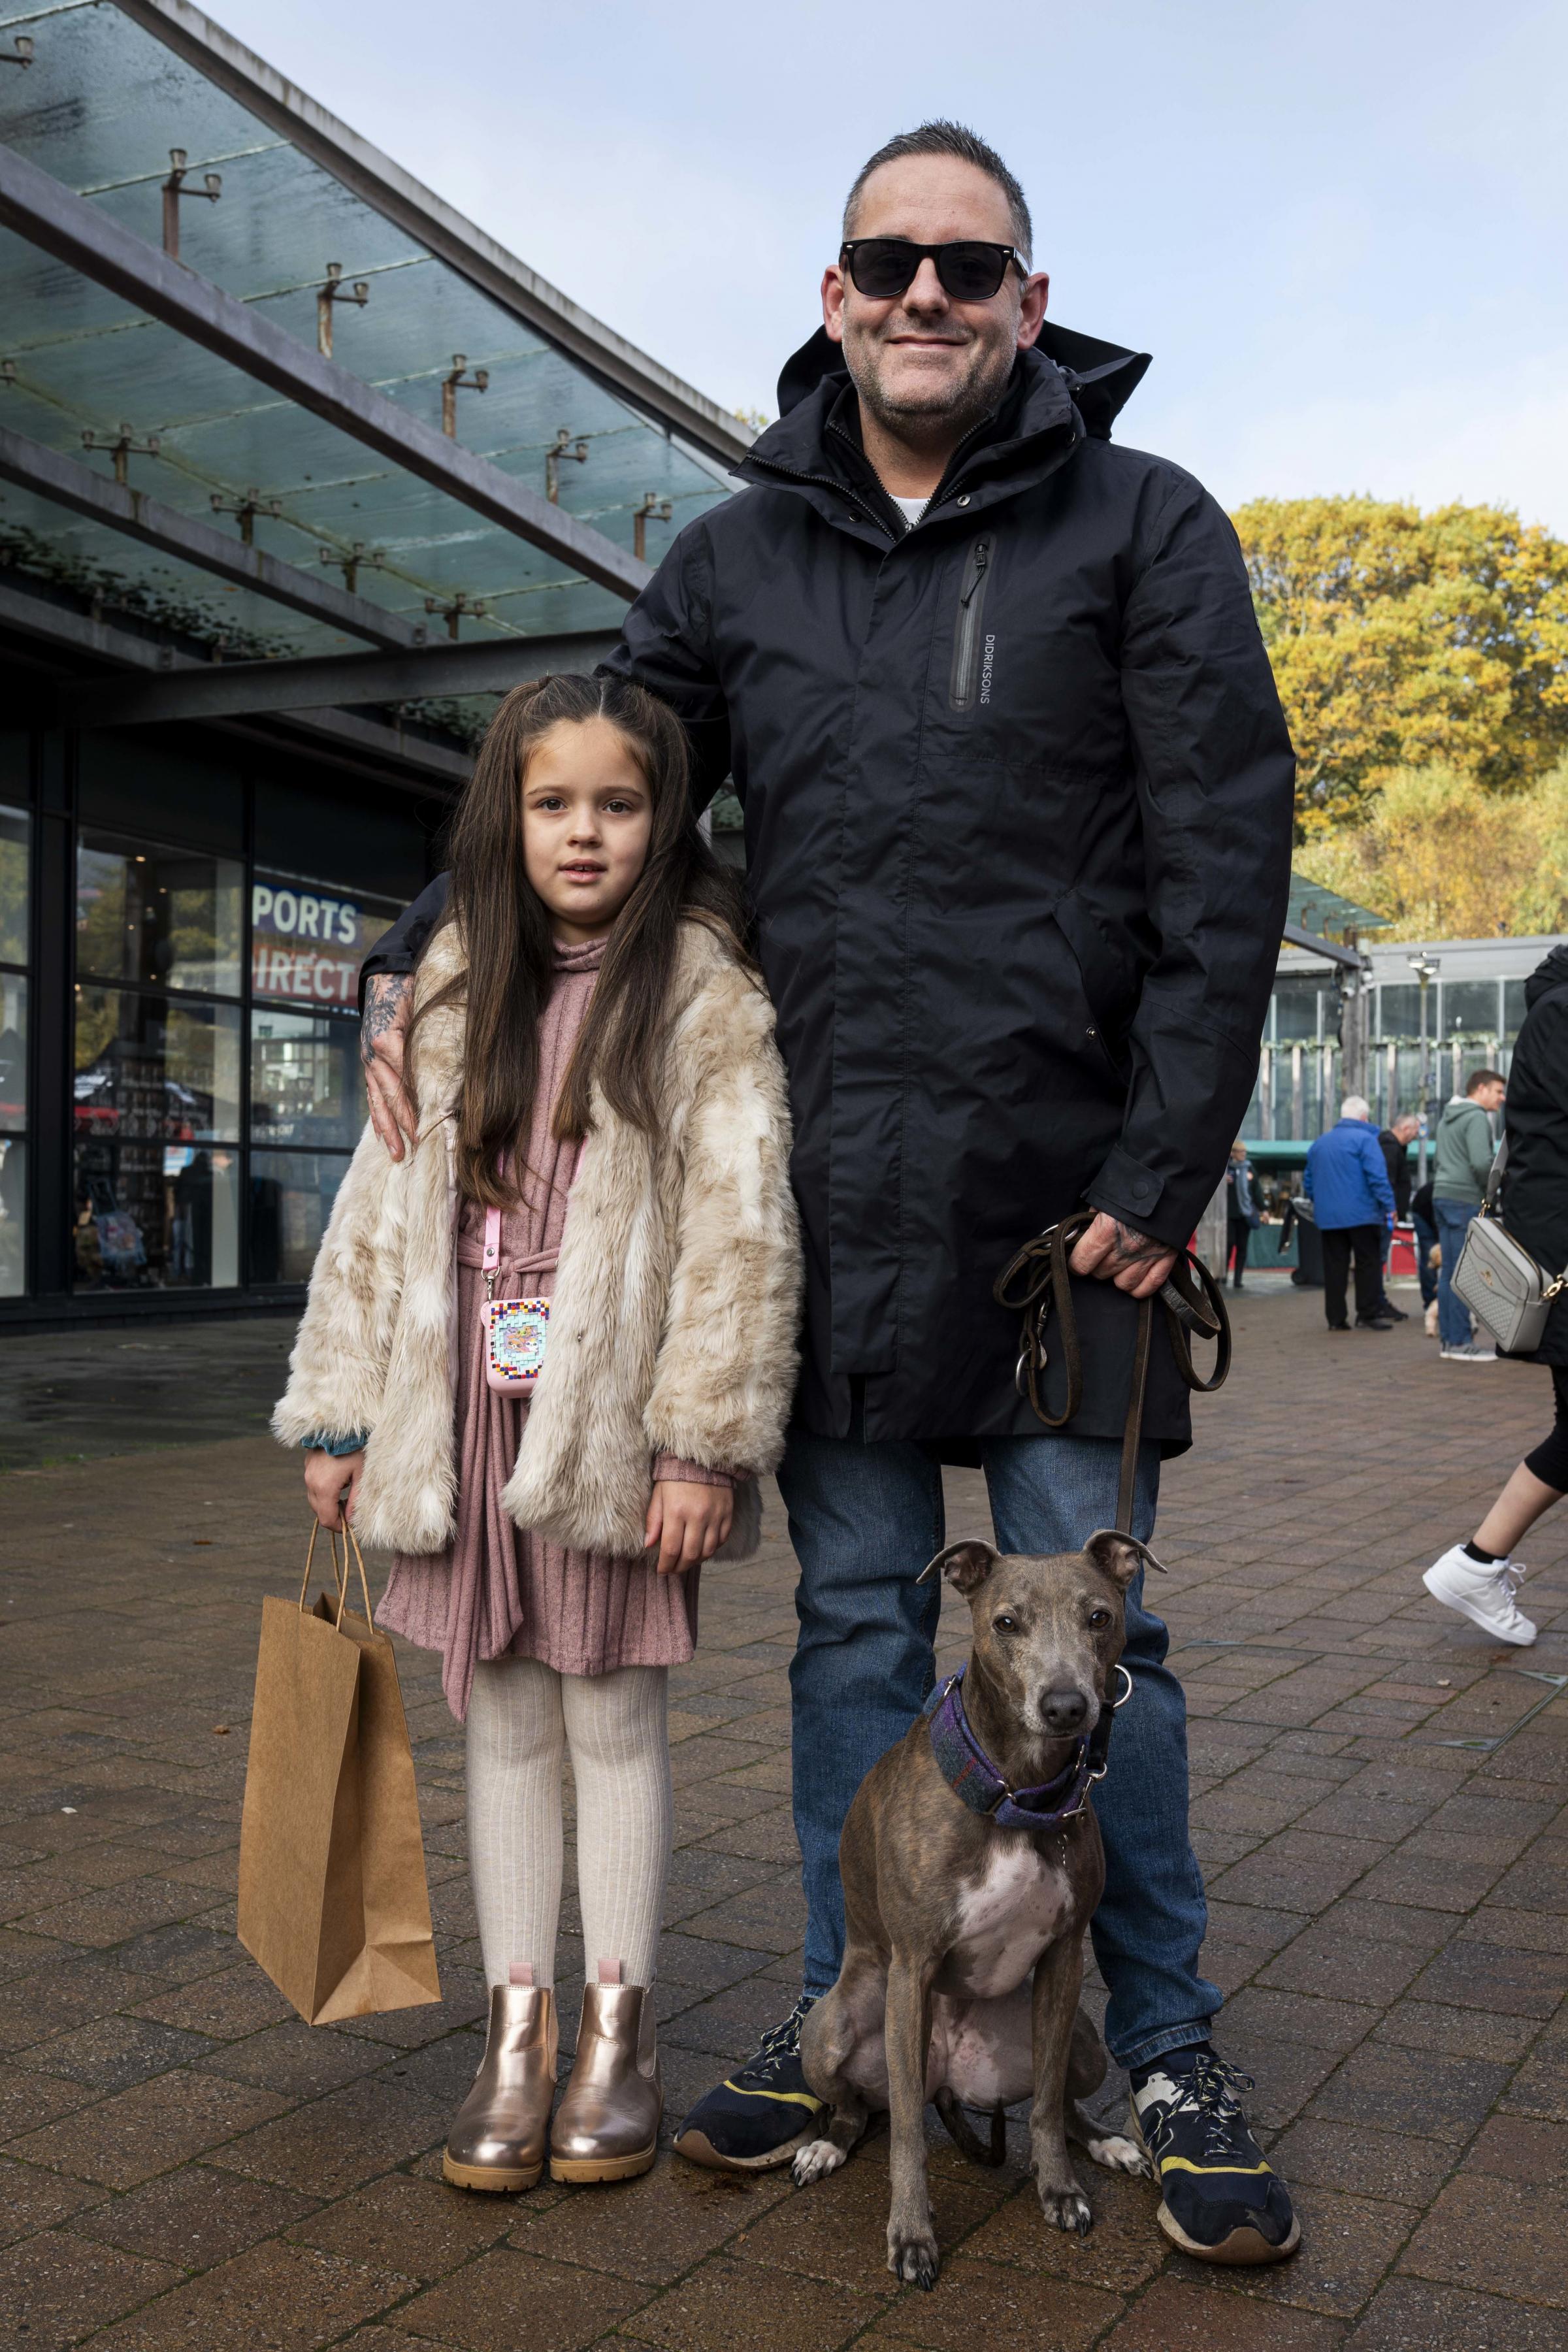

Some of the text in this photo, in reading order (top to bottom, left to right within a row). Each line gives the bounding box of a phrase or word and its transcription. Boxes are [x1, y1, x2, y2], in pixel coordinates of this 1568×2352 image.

[980, 634, 995, 704] DIDRIKSONS
[253, 885, 356, 943] PORTS
[253, 949, 355, 1000] IRECT
